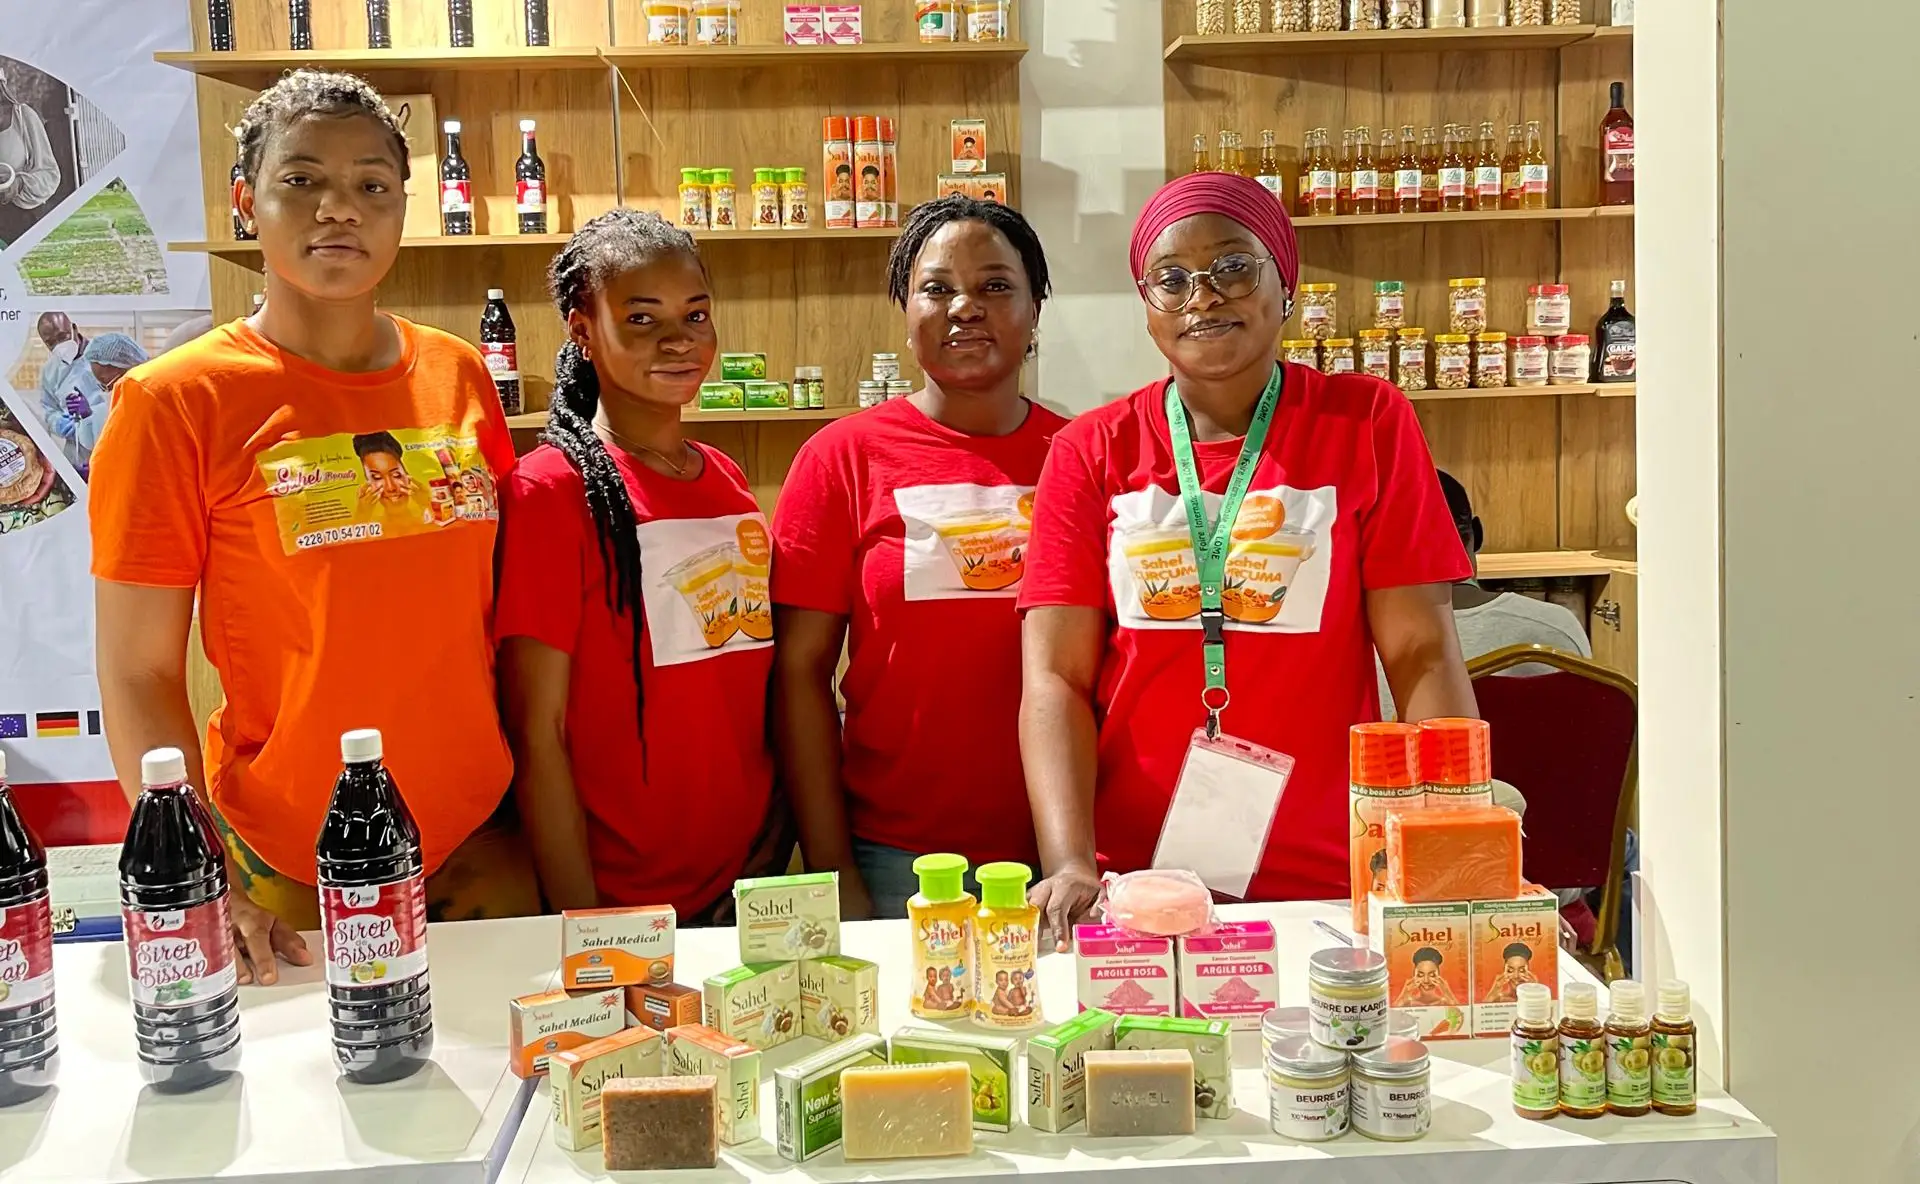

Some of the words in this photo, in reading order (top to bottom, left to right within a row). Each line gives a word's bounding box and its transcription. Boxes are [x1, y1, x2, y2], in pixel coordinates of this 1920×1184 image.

[298, 533, 323, 546] +228
[326, 530, 338, 542] 70
[341, 528, 353, 538] 54
[355, 526, 366, 537] 27
[369, 524, 380, 535] 02
[1211, 535, 1223, 560] LOME
[1140, 553, 1183, 569] Sahel
[1368, 788, 1396, 797] beauté
[1433, 784, 1461, 793] beauté
[747, 898, 793, 917] Sahel
[335, 919, 391, 945] Sirop
[582, 937, 613, 948] Sahel
[615, 933, 661, 945] Medical
[920, 917, 963, 942] Sahel
[988, 921, 1031, 945] Sahel
[1394, 919, 1453, 948] Sahel
[1485, 914, 1542, 943] Sahel
[136, 940, 198, 965] Sirop
[335, 939, 400, 969] Bissap
[139, 959, 207, 988] Bissap
[1097, 968, 1131, 977] ARGILE
[1133, 967, 1157, 976] ROSE
[1202, 965, 1237, 975] ARGILE
[1239, 964, 1264, 973] ROSE
[800, 973, 825, 994] ahel
[731, 986, 768, 1013] Sahel
[859, 989, 870, 1026] Sahel
[1344, 1004, 1358, 1014] DE
[538, 1020, 568, 1034] Sahel
[569, 1010, 612, 1028] Medical
[672, 1047, 703, 1076] Sahel
[1030, 1066, 1042, 1107] Sahel
[1296, 1092, 1336, 1103] BEURRE
[1337, 1089, 1345, 1099] DE
[552, 1085, 561, 1124] Sahel
[737, 1080, 750, 1121] Sahel
[808, 1110, 827, 1124] Super
